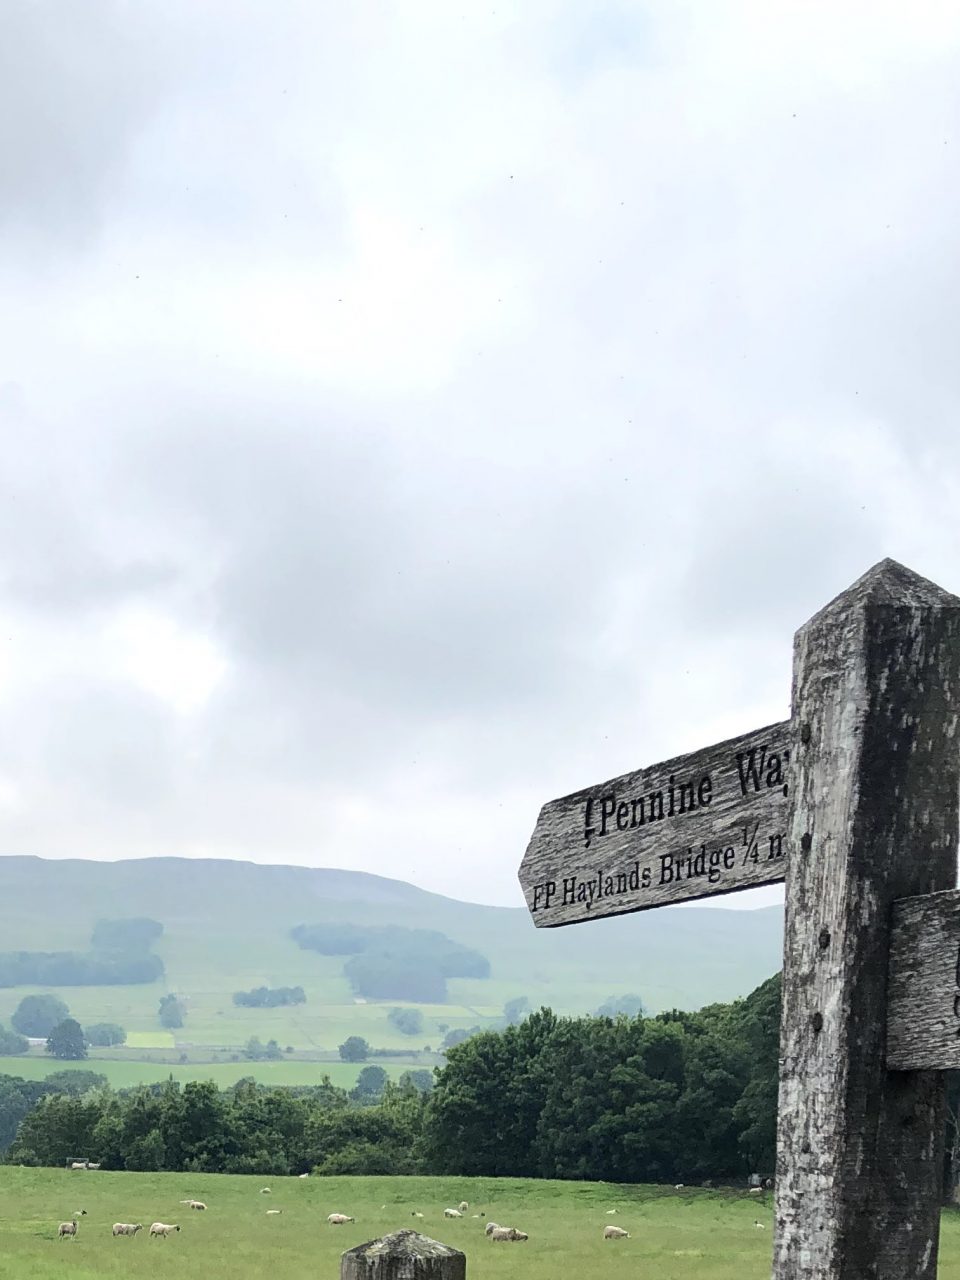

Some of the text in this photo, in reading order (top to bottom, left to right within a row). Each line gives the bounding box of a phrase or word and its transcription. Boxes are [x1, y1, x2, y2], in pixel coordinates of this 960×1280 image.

[599, 774, 713, 838] Pennine
[532, 881, 556, 913] FP
[562, 861, 652, 910] Haylands
[659, 844, 736, 884] Bridge
